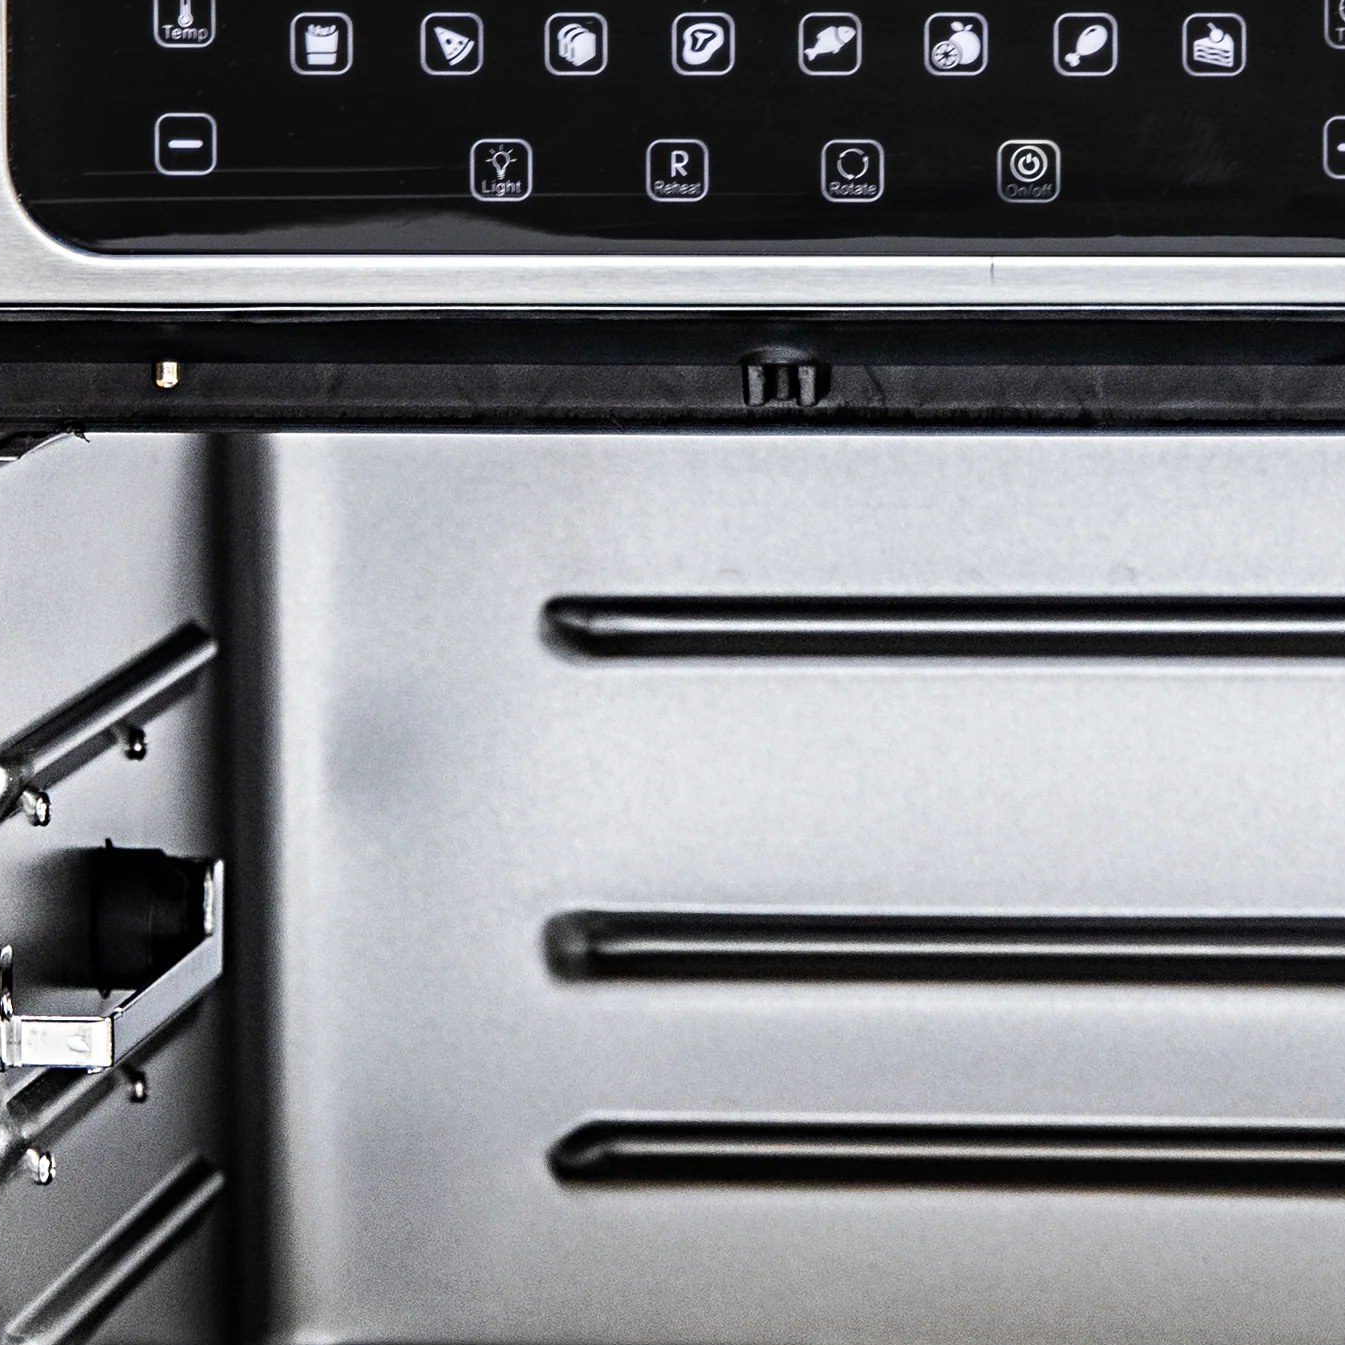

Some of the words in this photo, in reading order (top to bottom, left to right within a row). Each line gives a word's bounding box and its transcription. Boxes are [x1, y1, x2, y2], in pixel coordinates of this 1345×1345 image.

[161, 24, 209, 43] Temp
[670, 150, 689, 178] R
[481, 179, 523, 197] Light
[653, 180, 701, 195] Reheat
[829, 181, 877, 197] Rotate
